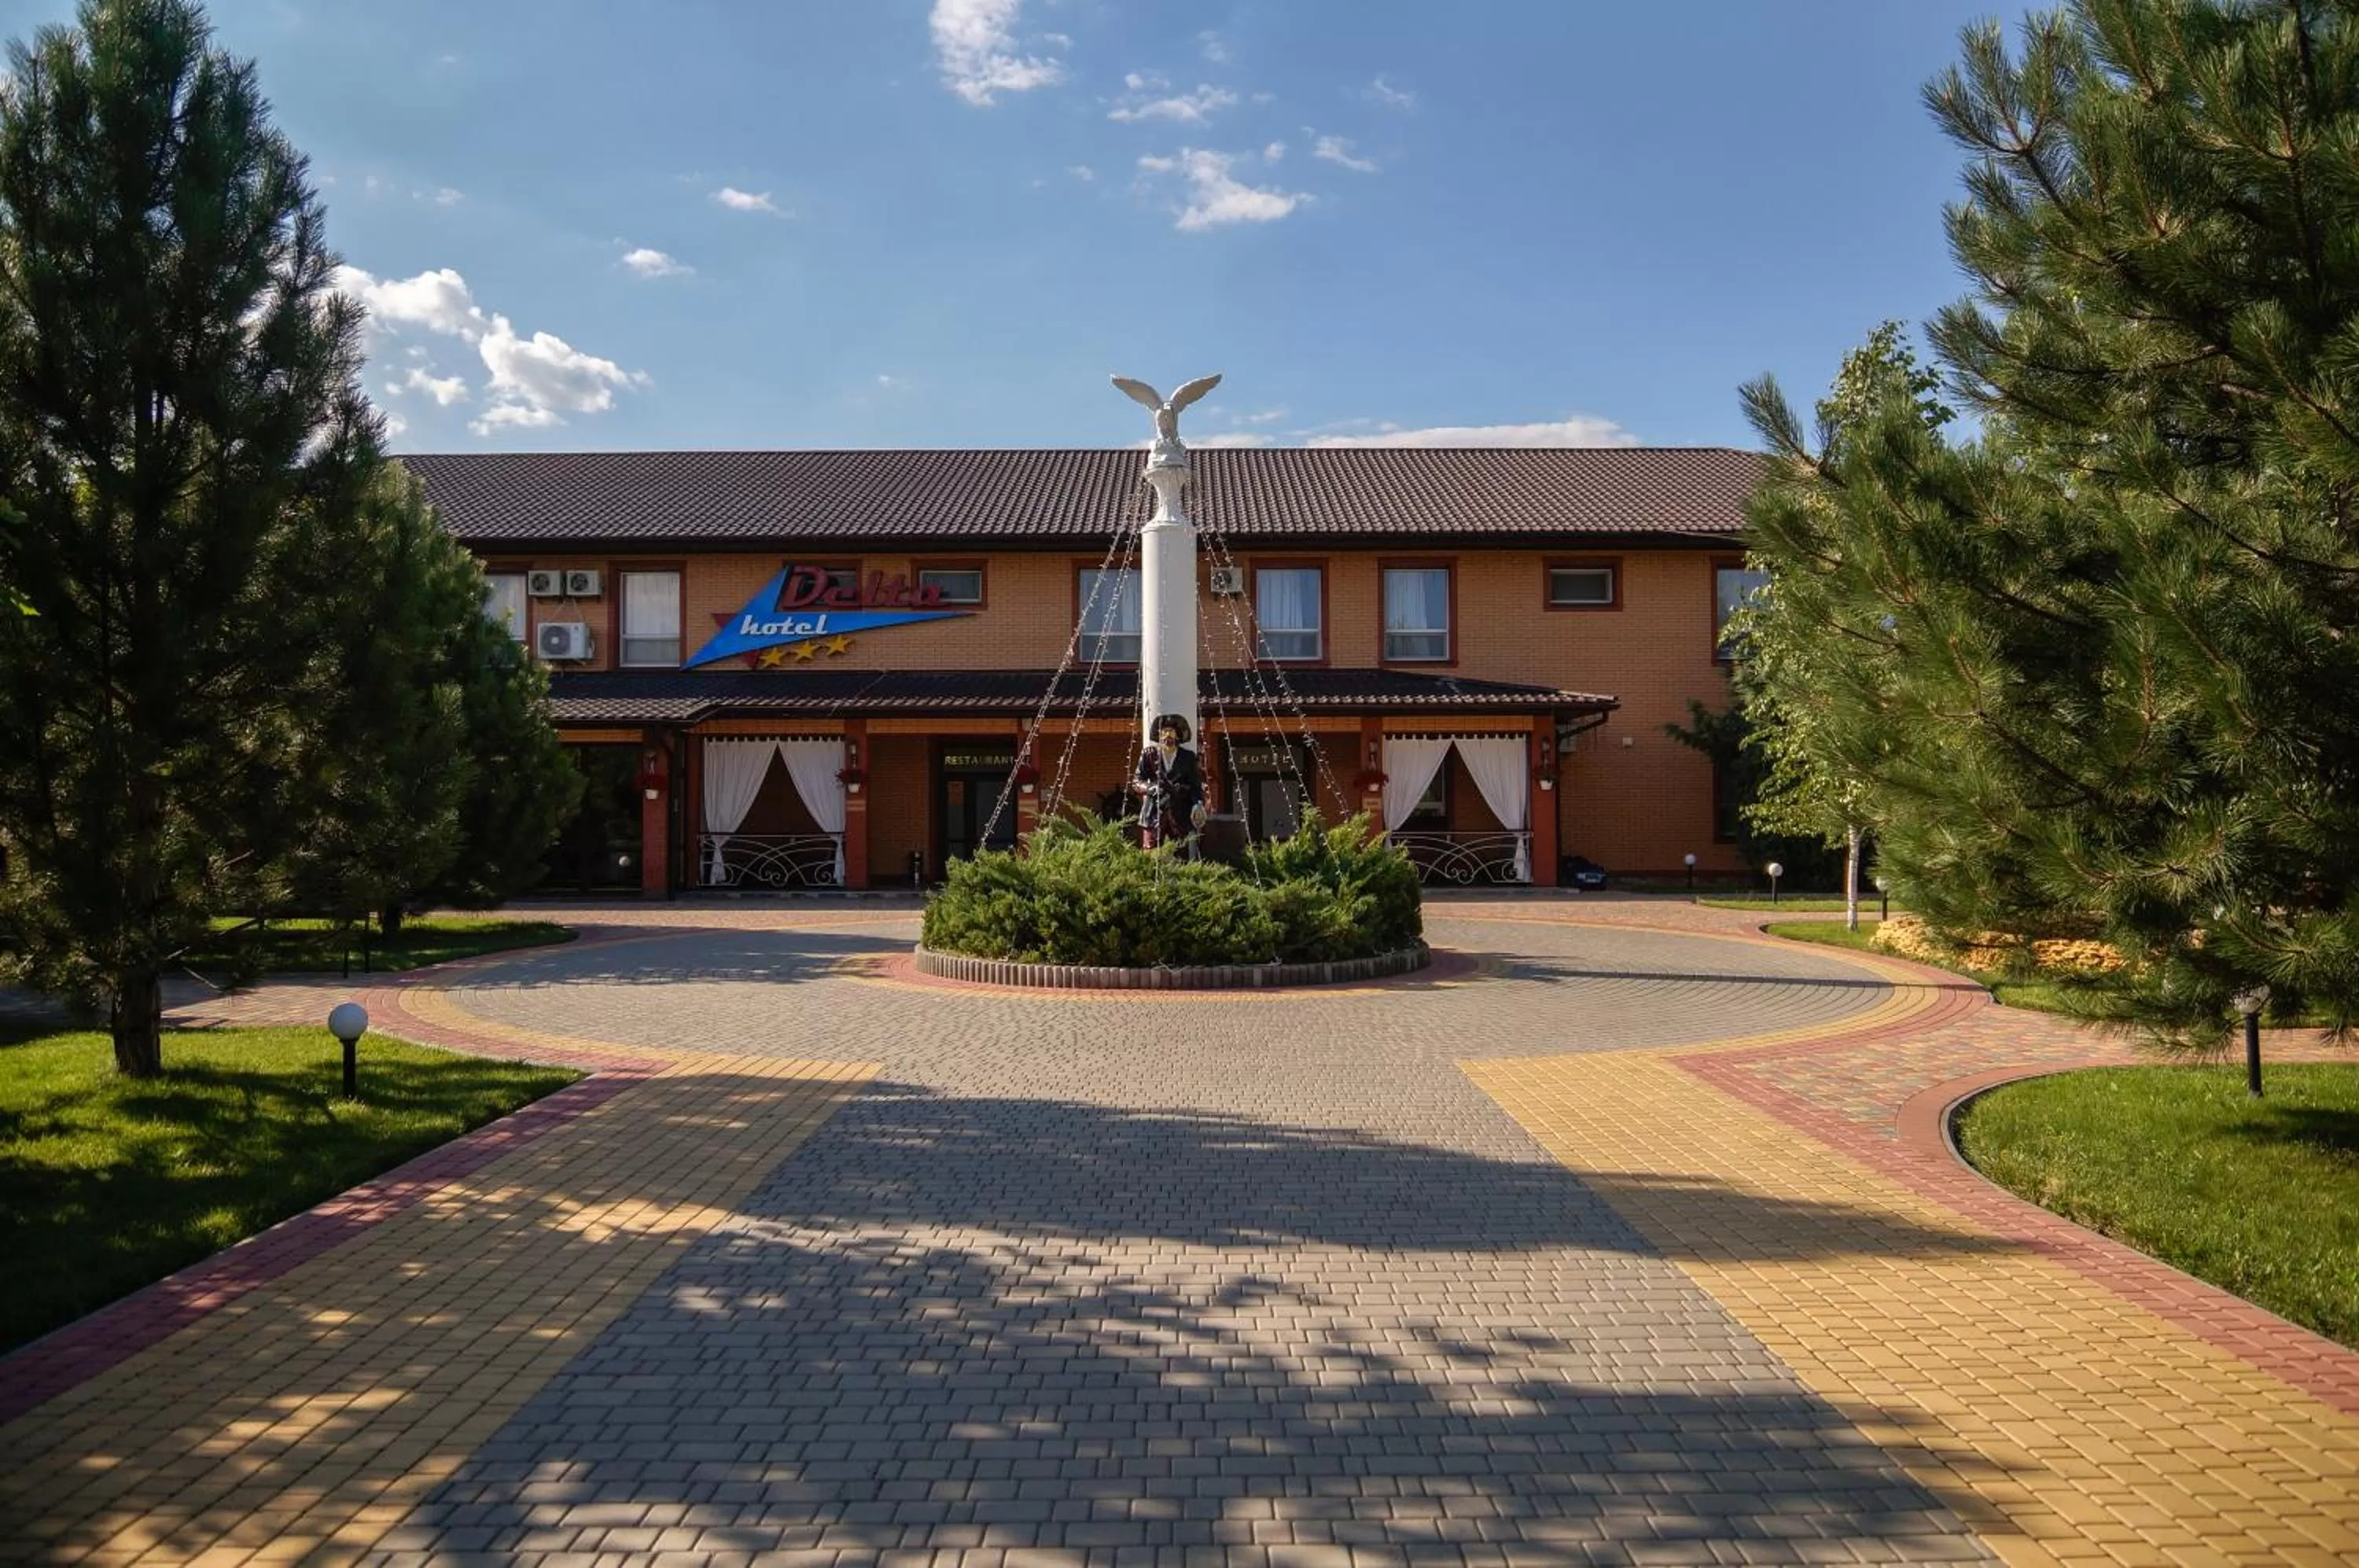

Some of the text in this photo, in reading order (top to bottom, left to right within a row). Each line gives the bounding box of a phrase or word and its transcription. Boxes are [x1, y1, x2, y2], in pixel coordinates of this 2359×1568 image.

[780, 565, 949, 608] Delta
[741, 614, 827, 635] hotel
[1238, 753, 1290, 764] HOTL
